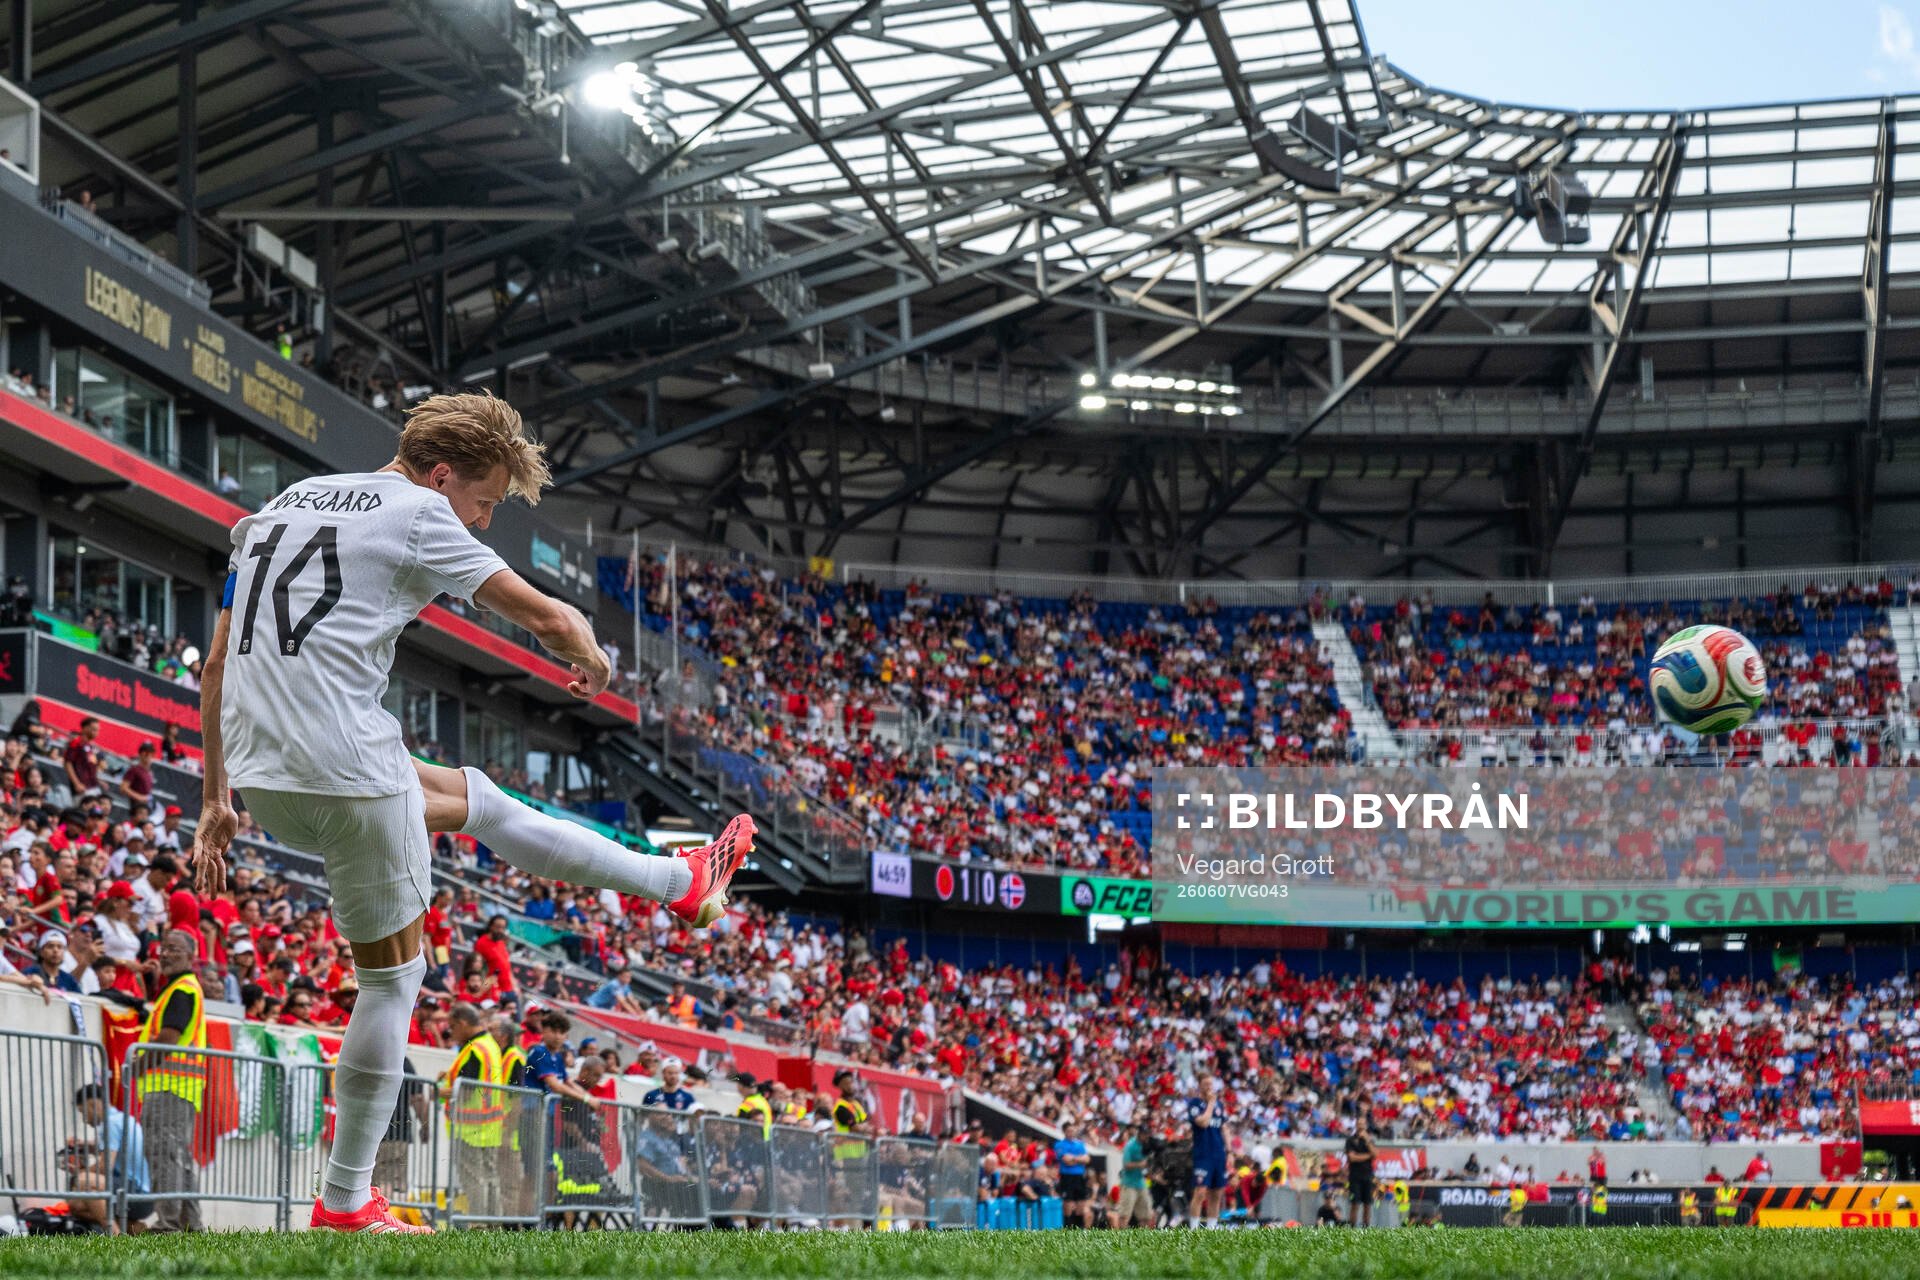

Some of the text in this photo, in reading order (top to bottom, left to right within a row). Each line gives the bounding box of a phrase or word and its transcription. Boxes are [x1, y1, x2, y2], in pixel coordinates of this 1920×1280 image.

[271, 491, 382, 512] ØDEGAARD
[238, 524, 343, 657] 10
[77, 664, 131, 708] Sports
[878, 864, 906, 884] 46:59
[1367, 893, 1407, 913] THE
[1685, 889, 1857, 922] GAME
[1441, 1189, 1487, 1206] ROAD
